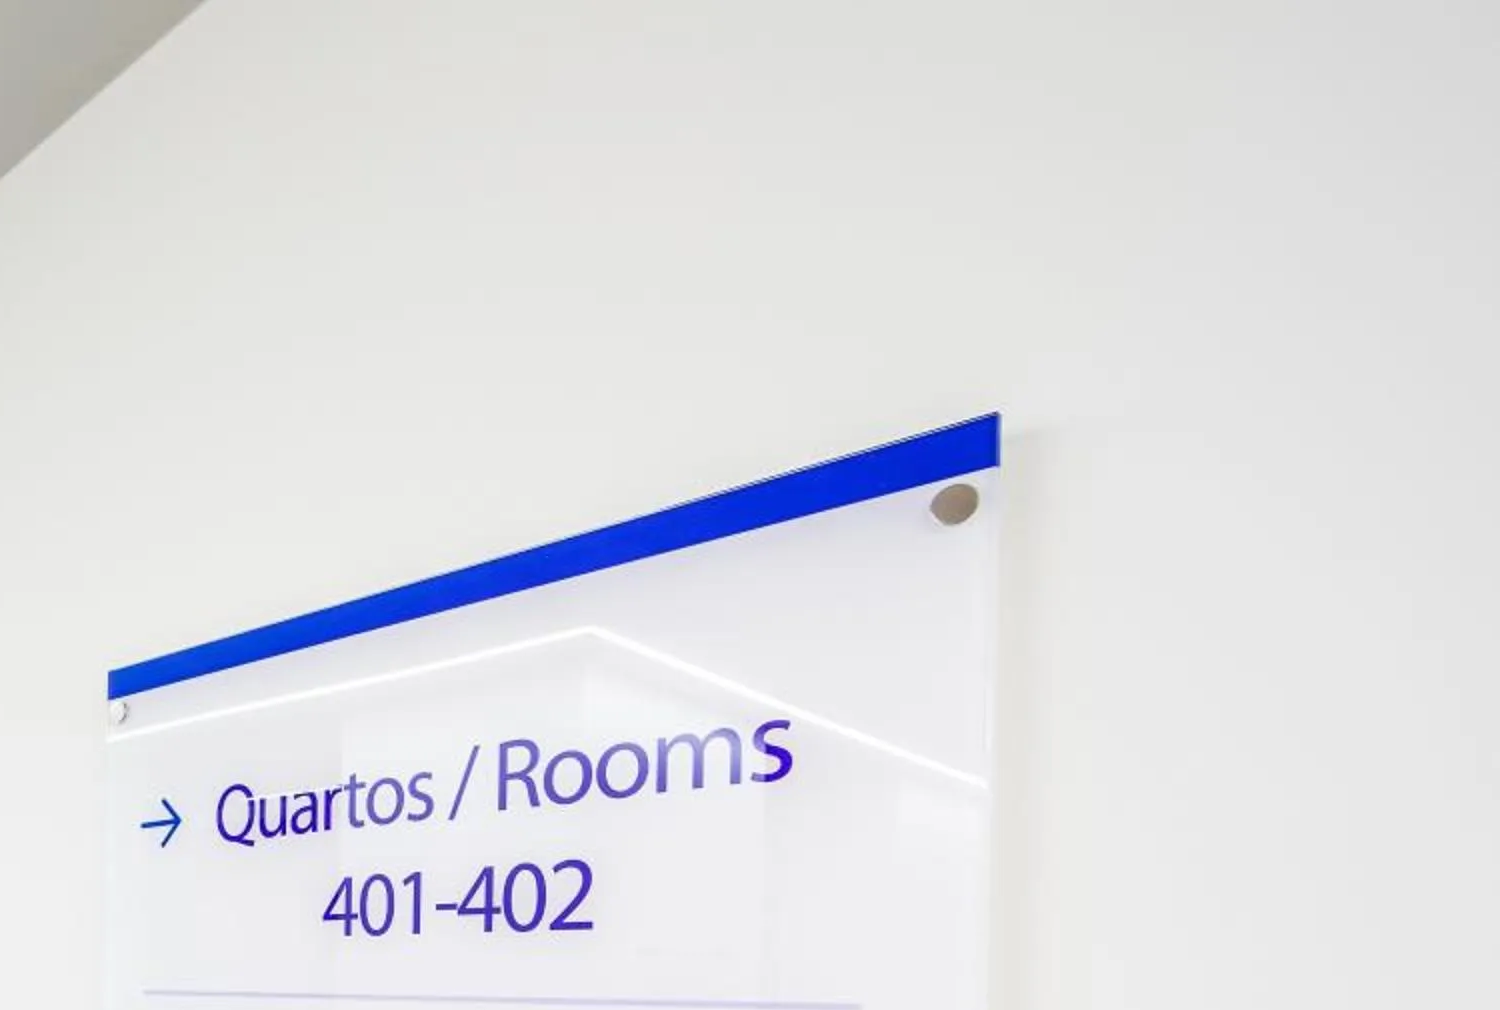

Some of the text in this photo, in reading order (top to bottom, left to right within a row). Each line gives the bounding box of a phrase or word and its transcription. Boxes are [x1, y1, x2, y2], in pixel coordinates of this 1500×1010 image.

[214, 718, 794, 846] Quartos / Rooms
[322, 859, 594, 937] 401-402
